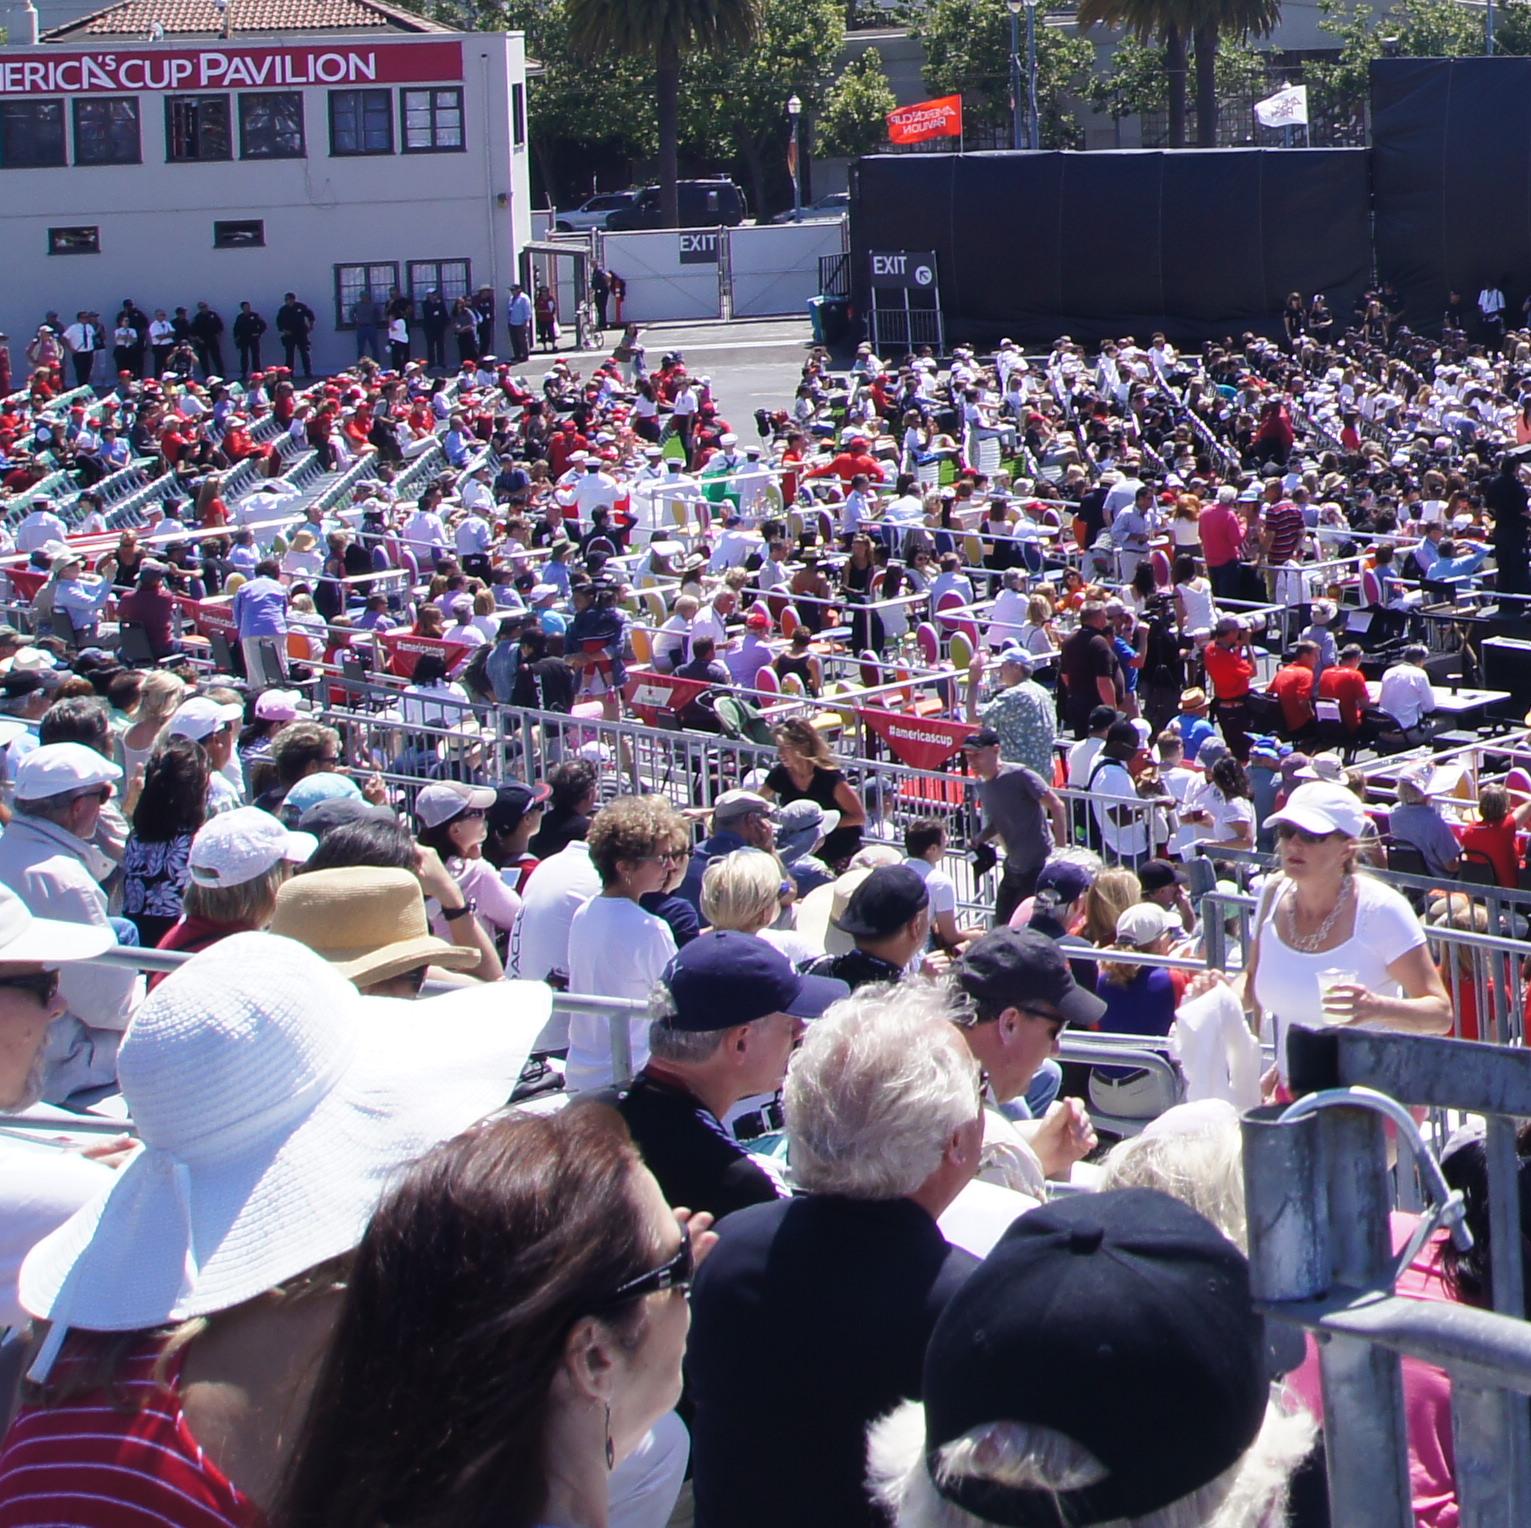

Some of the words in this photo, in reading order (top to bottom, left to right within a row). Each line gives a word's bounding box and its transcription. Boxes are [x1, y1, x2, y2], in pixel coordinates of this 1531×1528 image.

[0, 54, 118, 92] ERICA'S
[118, 57, 194, 89] CUP
[200, 51, 377, 87] PAVILION
[680, 233, 717, 252] EXIT
[873, 256, 907, 274] EXIT
[888, 724, 953, 748] #americascup
